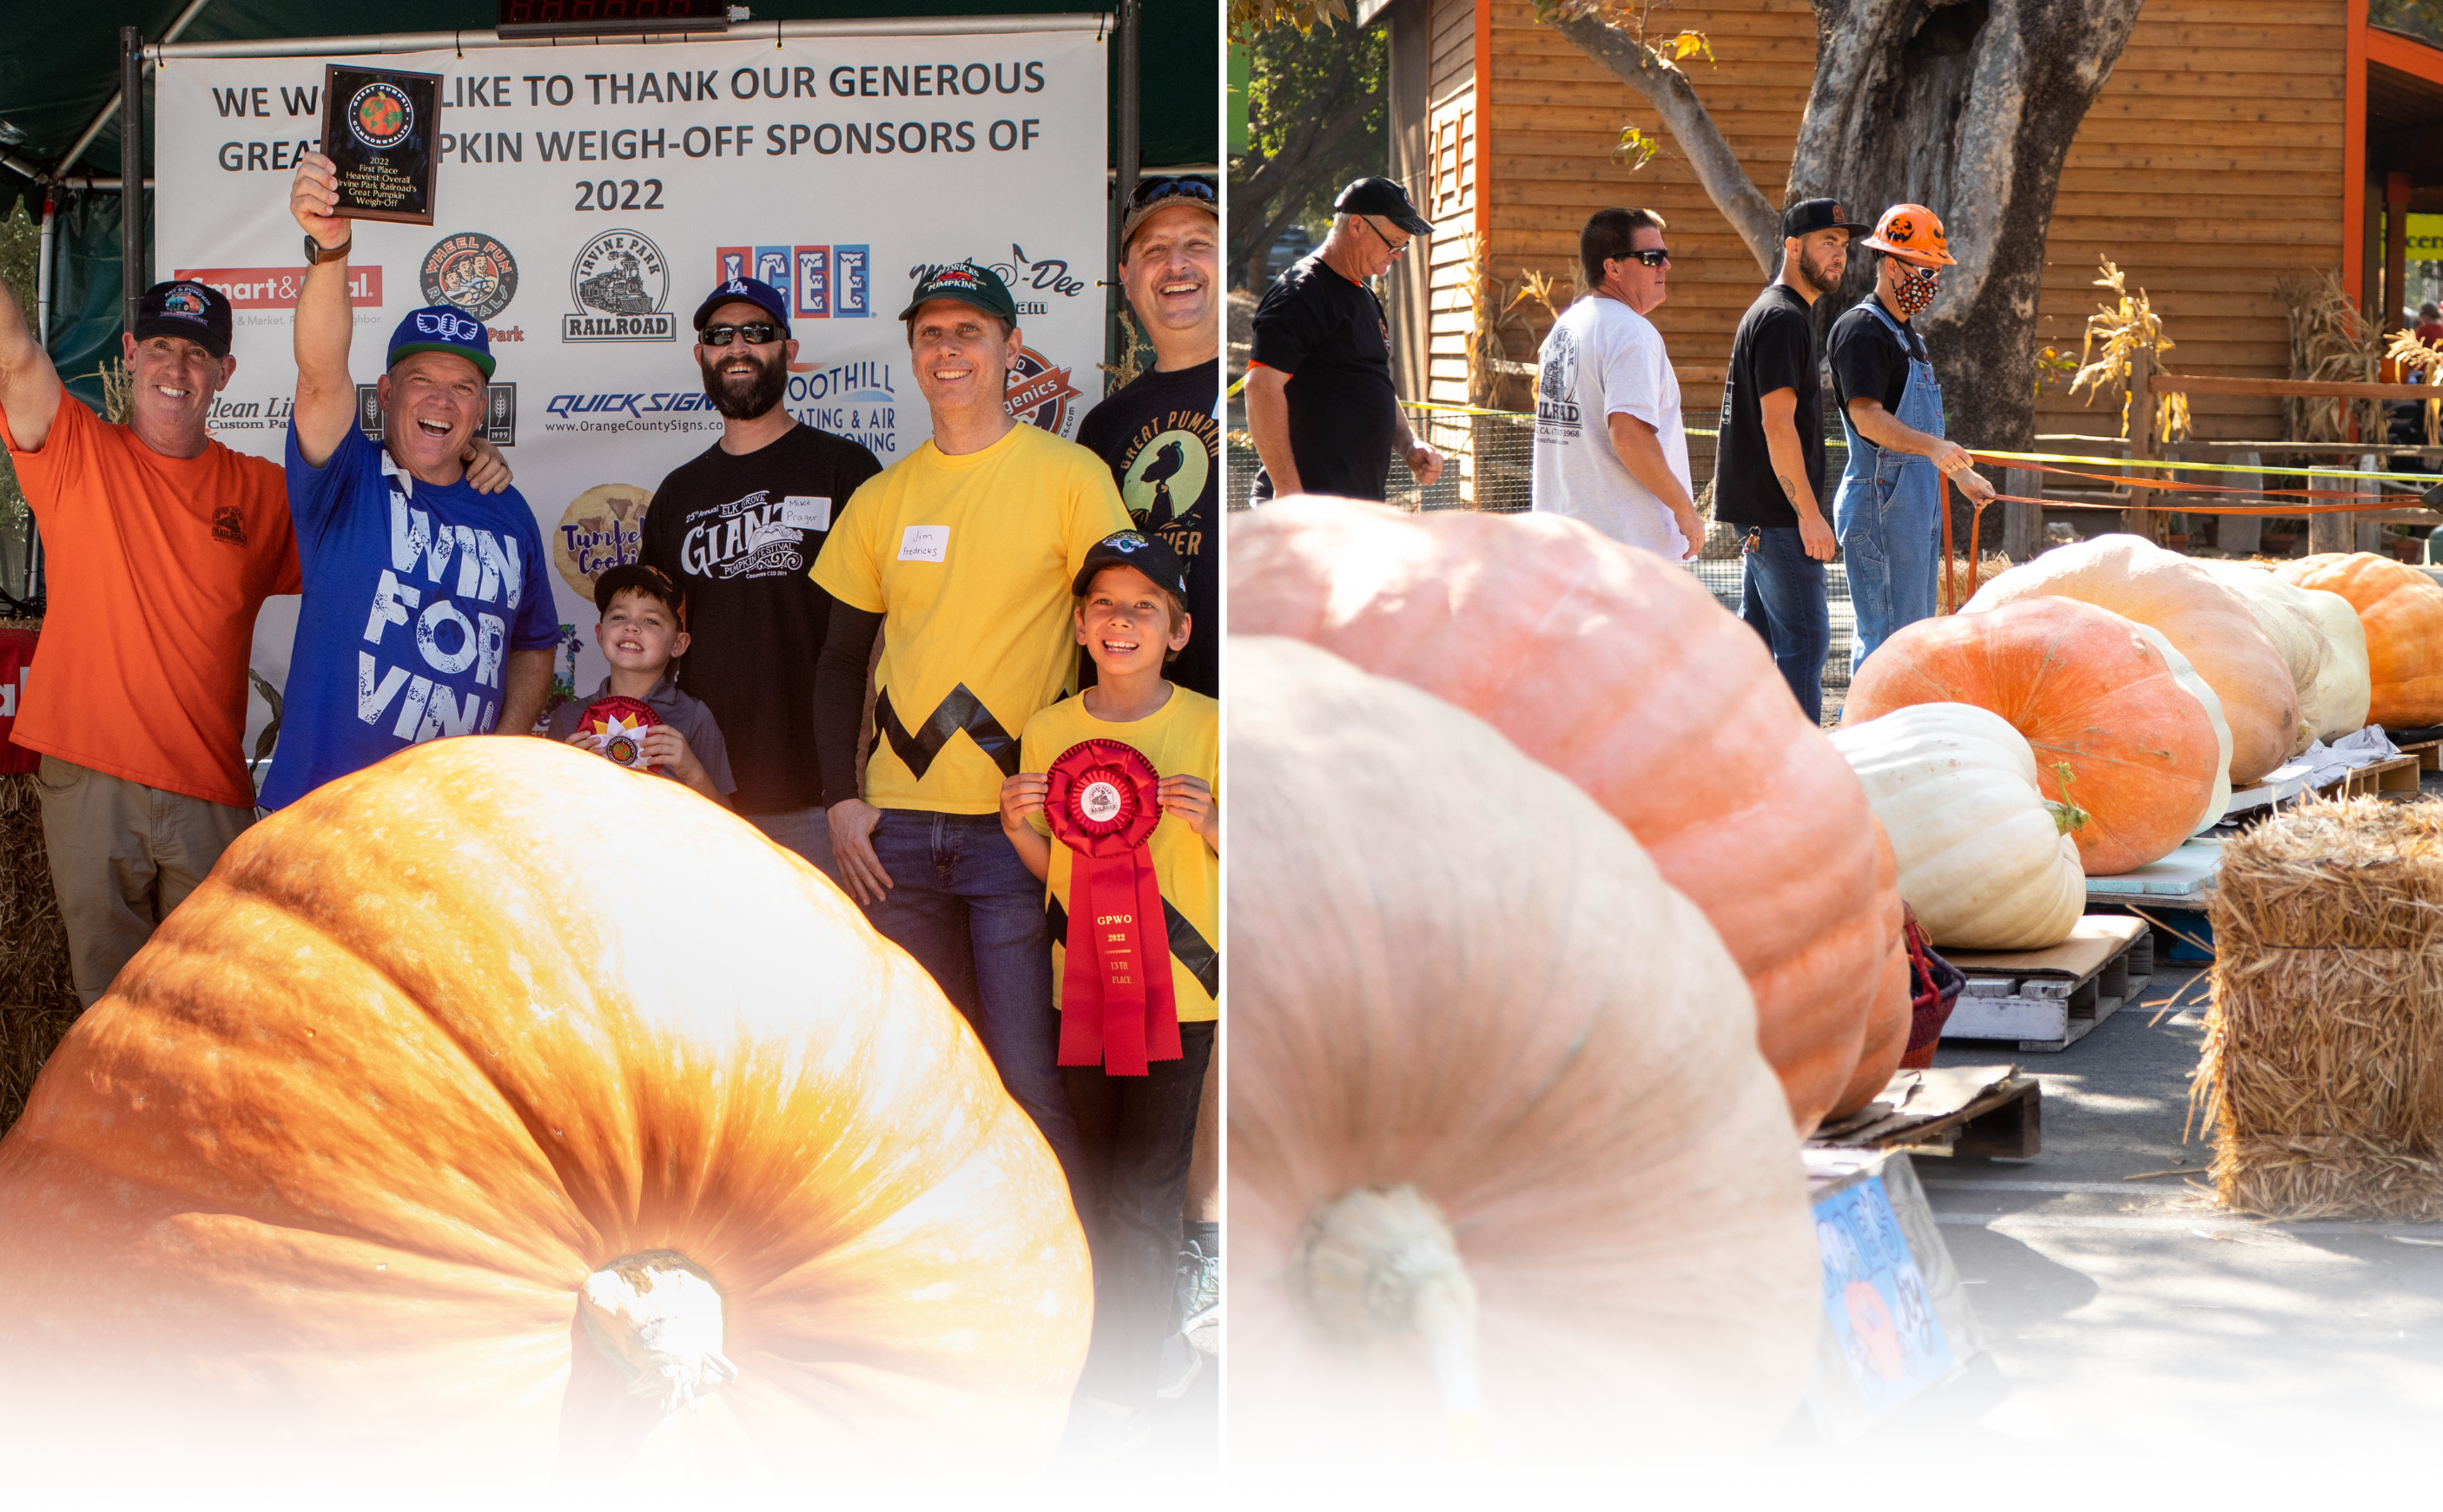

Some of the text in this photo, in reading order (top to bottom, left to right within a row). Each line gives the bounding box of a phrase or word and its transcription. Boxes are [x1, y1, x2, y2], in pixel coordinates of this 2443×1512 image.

[212, 87, 271, 117] WE
[523, 75, 574, 106] TO
[584, 69, 719, 105] THANK
[730, 66, 817, 100] OUR
[829, 61, 1046, 97] GENEROUS
[353, 86, 375, 107] GREAT
[380, 85, 411, 114] PUMPKIN
[353, 120, 409, 145] COMMONWEALTH
[438, 131, 523, 163] PKIN
[536, 124, 754, 162] WEIGH-OFF
[766, 120, 976, 156] SPONSORS
[988, 118, 1040, 152] OF
[359, 164, 399, 175] First Place
[369, 157, 389, 166] 2022
[338, 179, 417, 192] Irvine Park Railroad's
[346, 171, 411, 184] Heaviest Overall
[348, 188, 406, 201] Great Pumpkin
[356, 196, 398, 208] Weigh-Off
[574, 178, 664, 212] 2022
[426, 236, 512, 274] WHEEL FUN
[579, 237, 661, 277] IRVINE PARK
[721, 248, 868, 315] ICEE
[927, 280, 977, 293] PUMPKINS
[184, 287, 212, 307] PUMPKIN
[426, 285, 508, 318] RETALS
[238, 316, 245, 326] &
[248, 315, 286, 326] Market.
[569, 317, 669, 336] RAILROAD
[487, 325, 525, 342] Park
[788, 360, 895, 402] OOTHILL
[546, 393, 719, 419] QUICK SIGN
[1003, 379, 1058, 415] genics
[208, 419, 265, 429] Custom
[545, 419, 723, 433] www.OrangeCountySigns.co
[851, 410, 861, 429] &
[869, 407, 895, 429] AIR
[1120, 417, 1159, 470] GREAT
[697, 505, 719, 517] Annual
[722, 492, 766, 516] ELK GROVE
[786, 510, 818, 525] Prager
[913, 530, 933, 543] Jim
[389, 488, 522, 611] WIN
[756, 542, 795, 559] FESTIVAL
[903, 546, 938, 557] Fredricks
[724, 554, 756, 576] PUMPKIN
[363, 569, 505, 690] FOR
[1097, 914, 1132, 925] GPWO
[1107, 933, 1126, 942] 2022
[1112, 975, 1132, 984] PLACE
[1071, 1451, 1113, 1471] crocs
